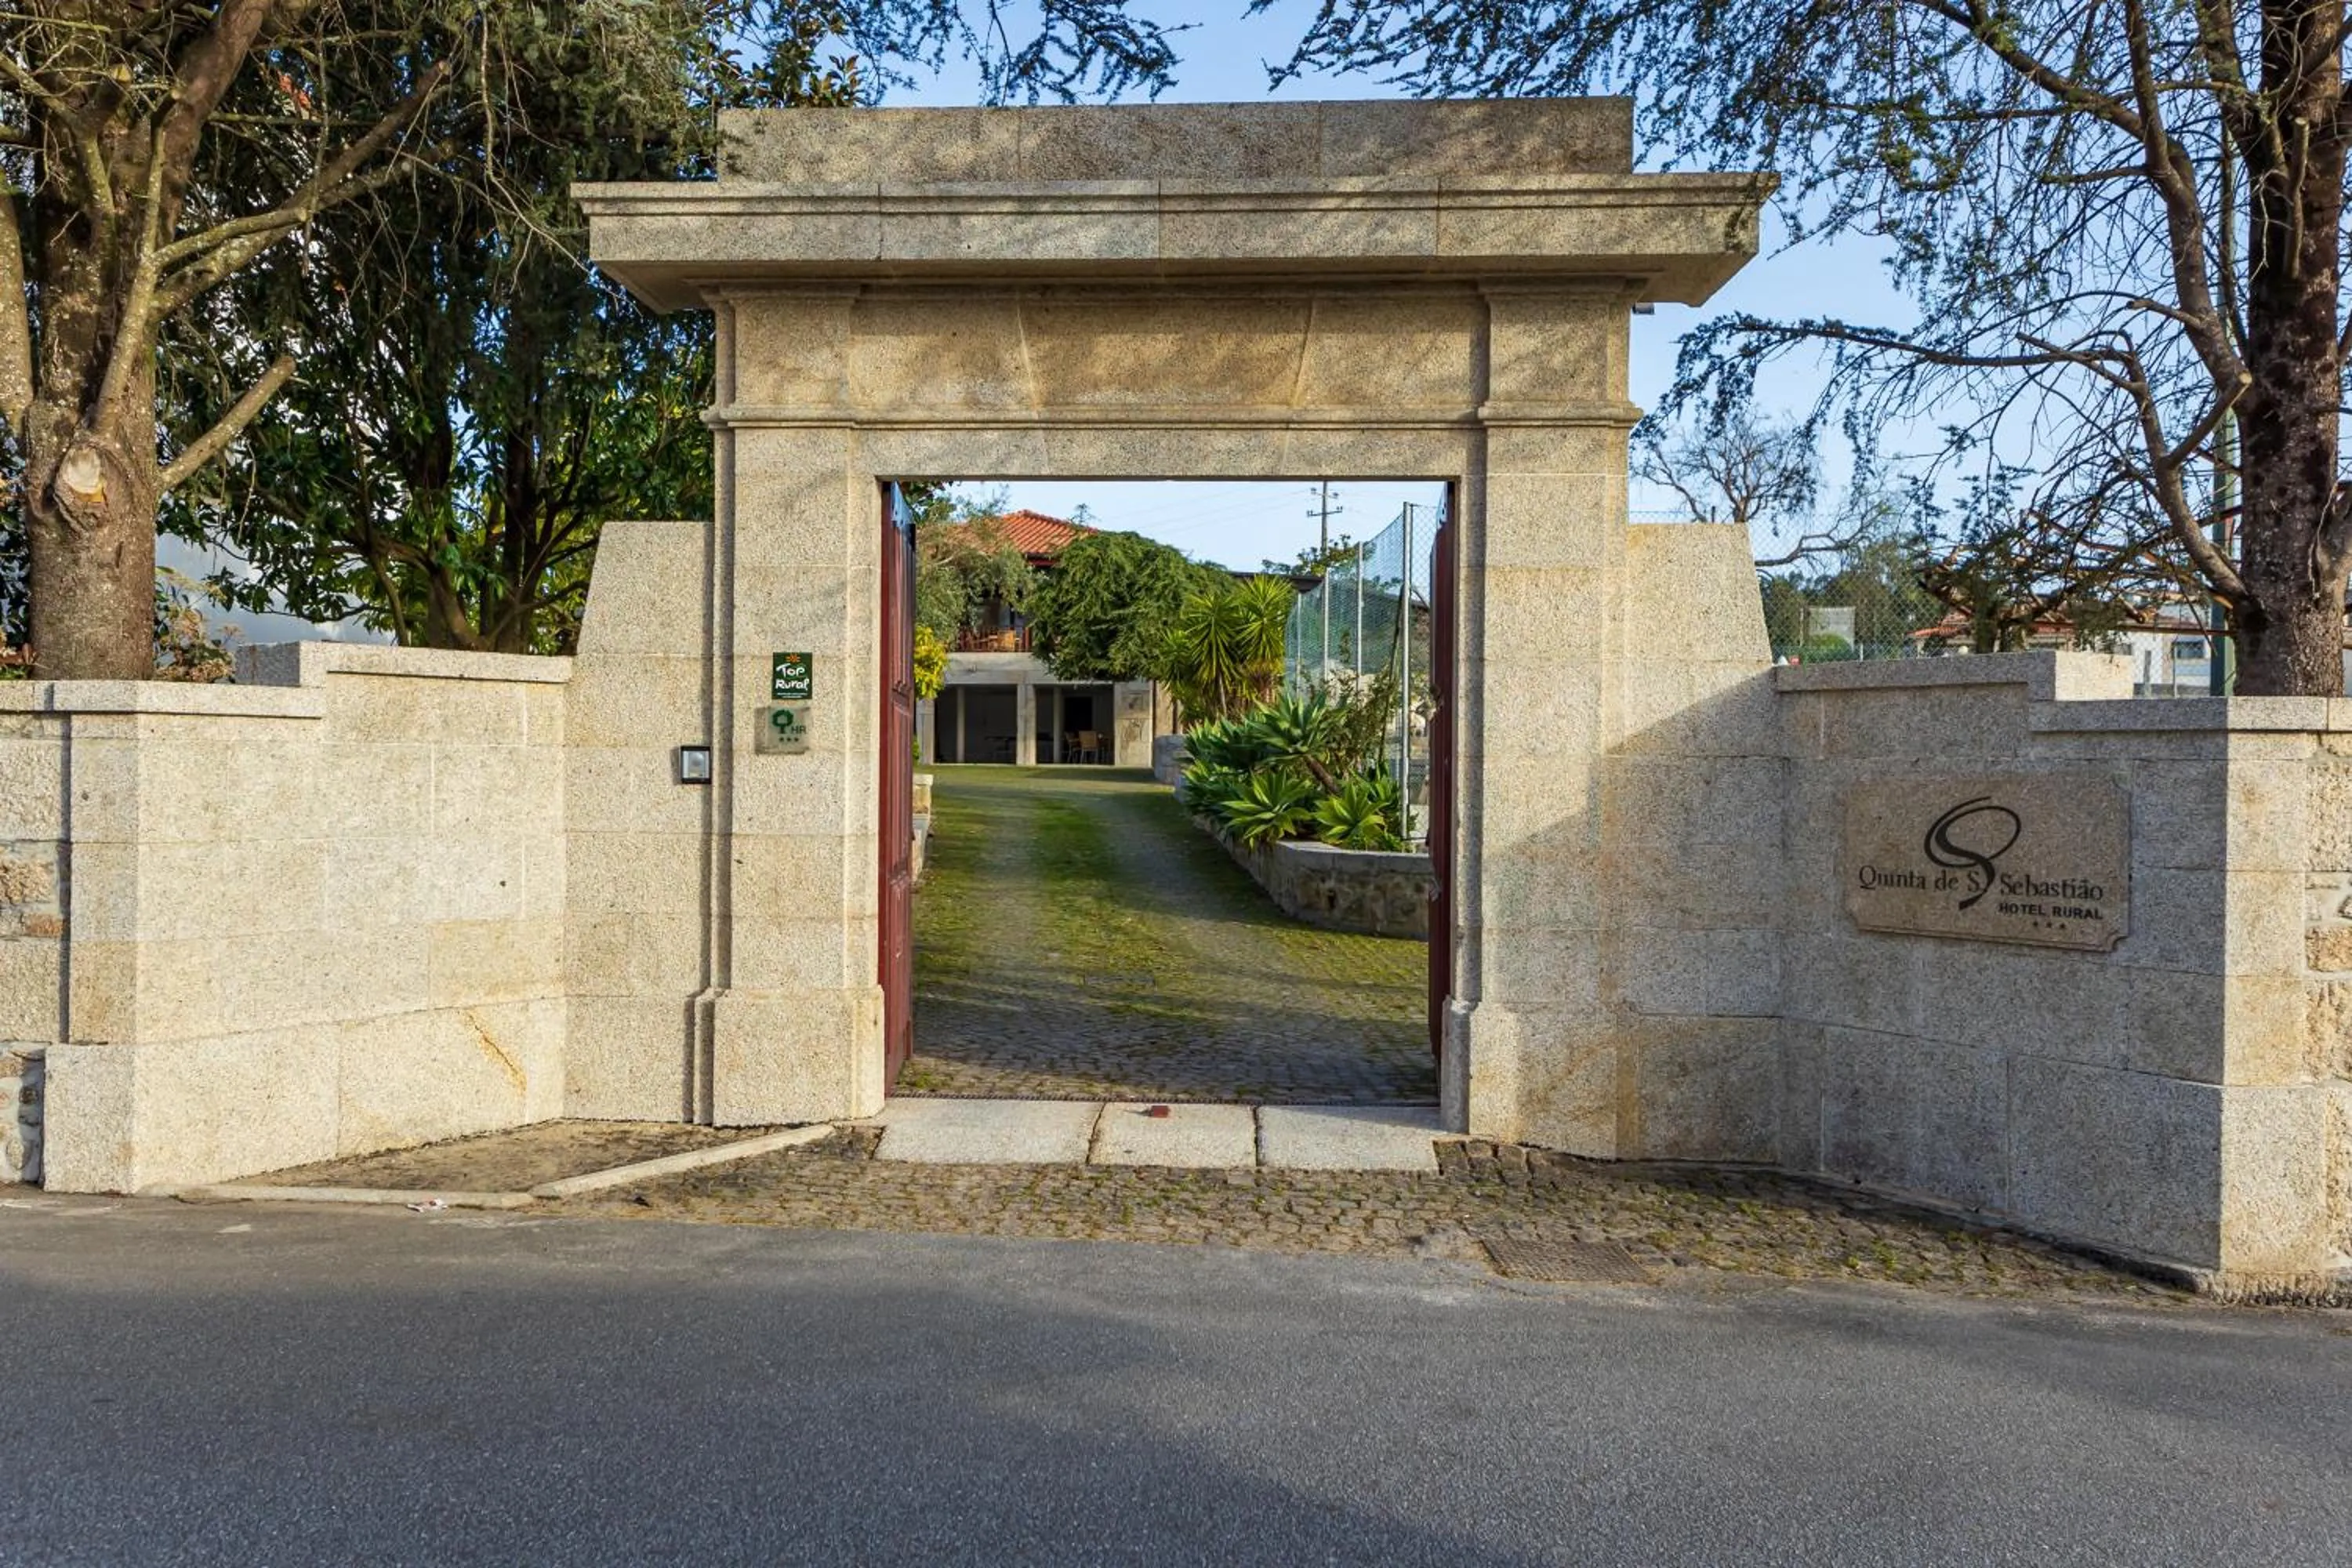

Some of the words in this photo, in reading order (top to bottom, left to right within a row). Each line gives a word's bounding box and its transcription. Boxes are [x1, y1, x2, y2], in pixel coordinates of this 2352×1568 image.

[775, 678, 810, 691] Rural
[790, 725, 807, 735] HR
[1859, 865, 1926, 891] Quinta
[1933, 869, 1959, 892] de
[2000, 872, 2103, 901] Sebastião
[1998, 902, 2046, 916] HOTEL
[2052, 906, 2103, 920] RURAL
